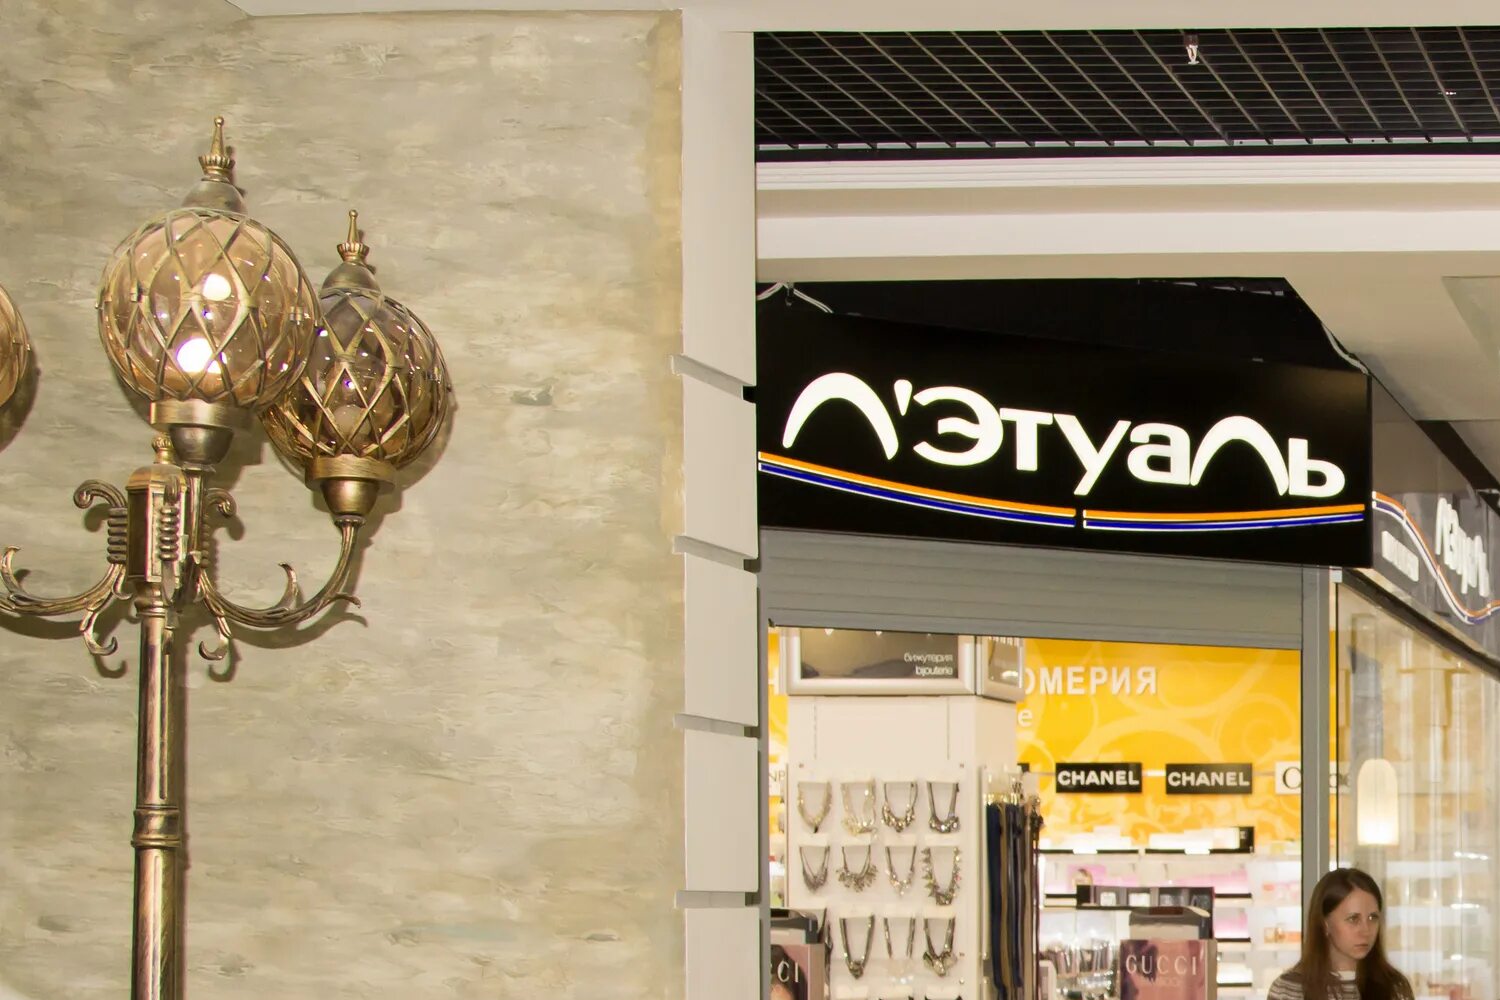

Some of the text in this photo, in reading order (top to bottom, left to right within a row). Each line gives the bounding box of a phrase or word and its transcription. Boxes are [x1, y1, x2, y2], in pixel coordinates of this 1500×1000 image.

[1057, 769, 1140, 787] CHANEL
[1167, 770, 1250, 787] CHANEL
[1125, 954, 1197, 976] GUCCI
